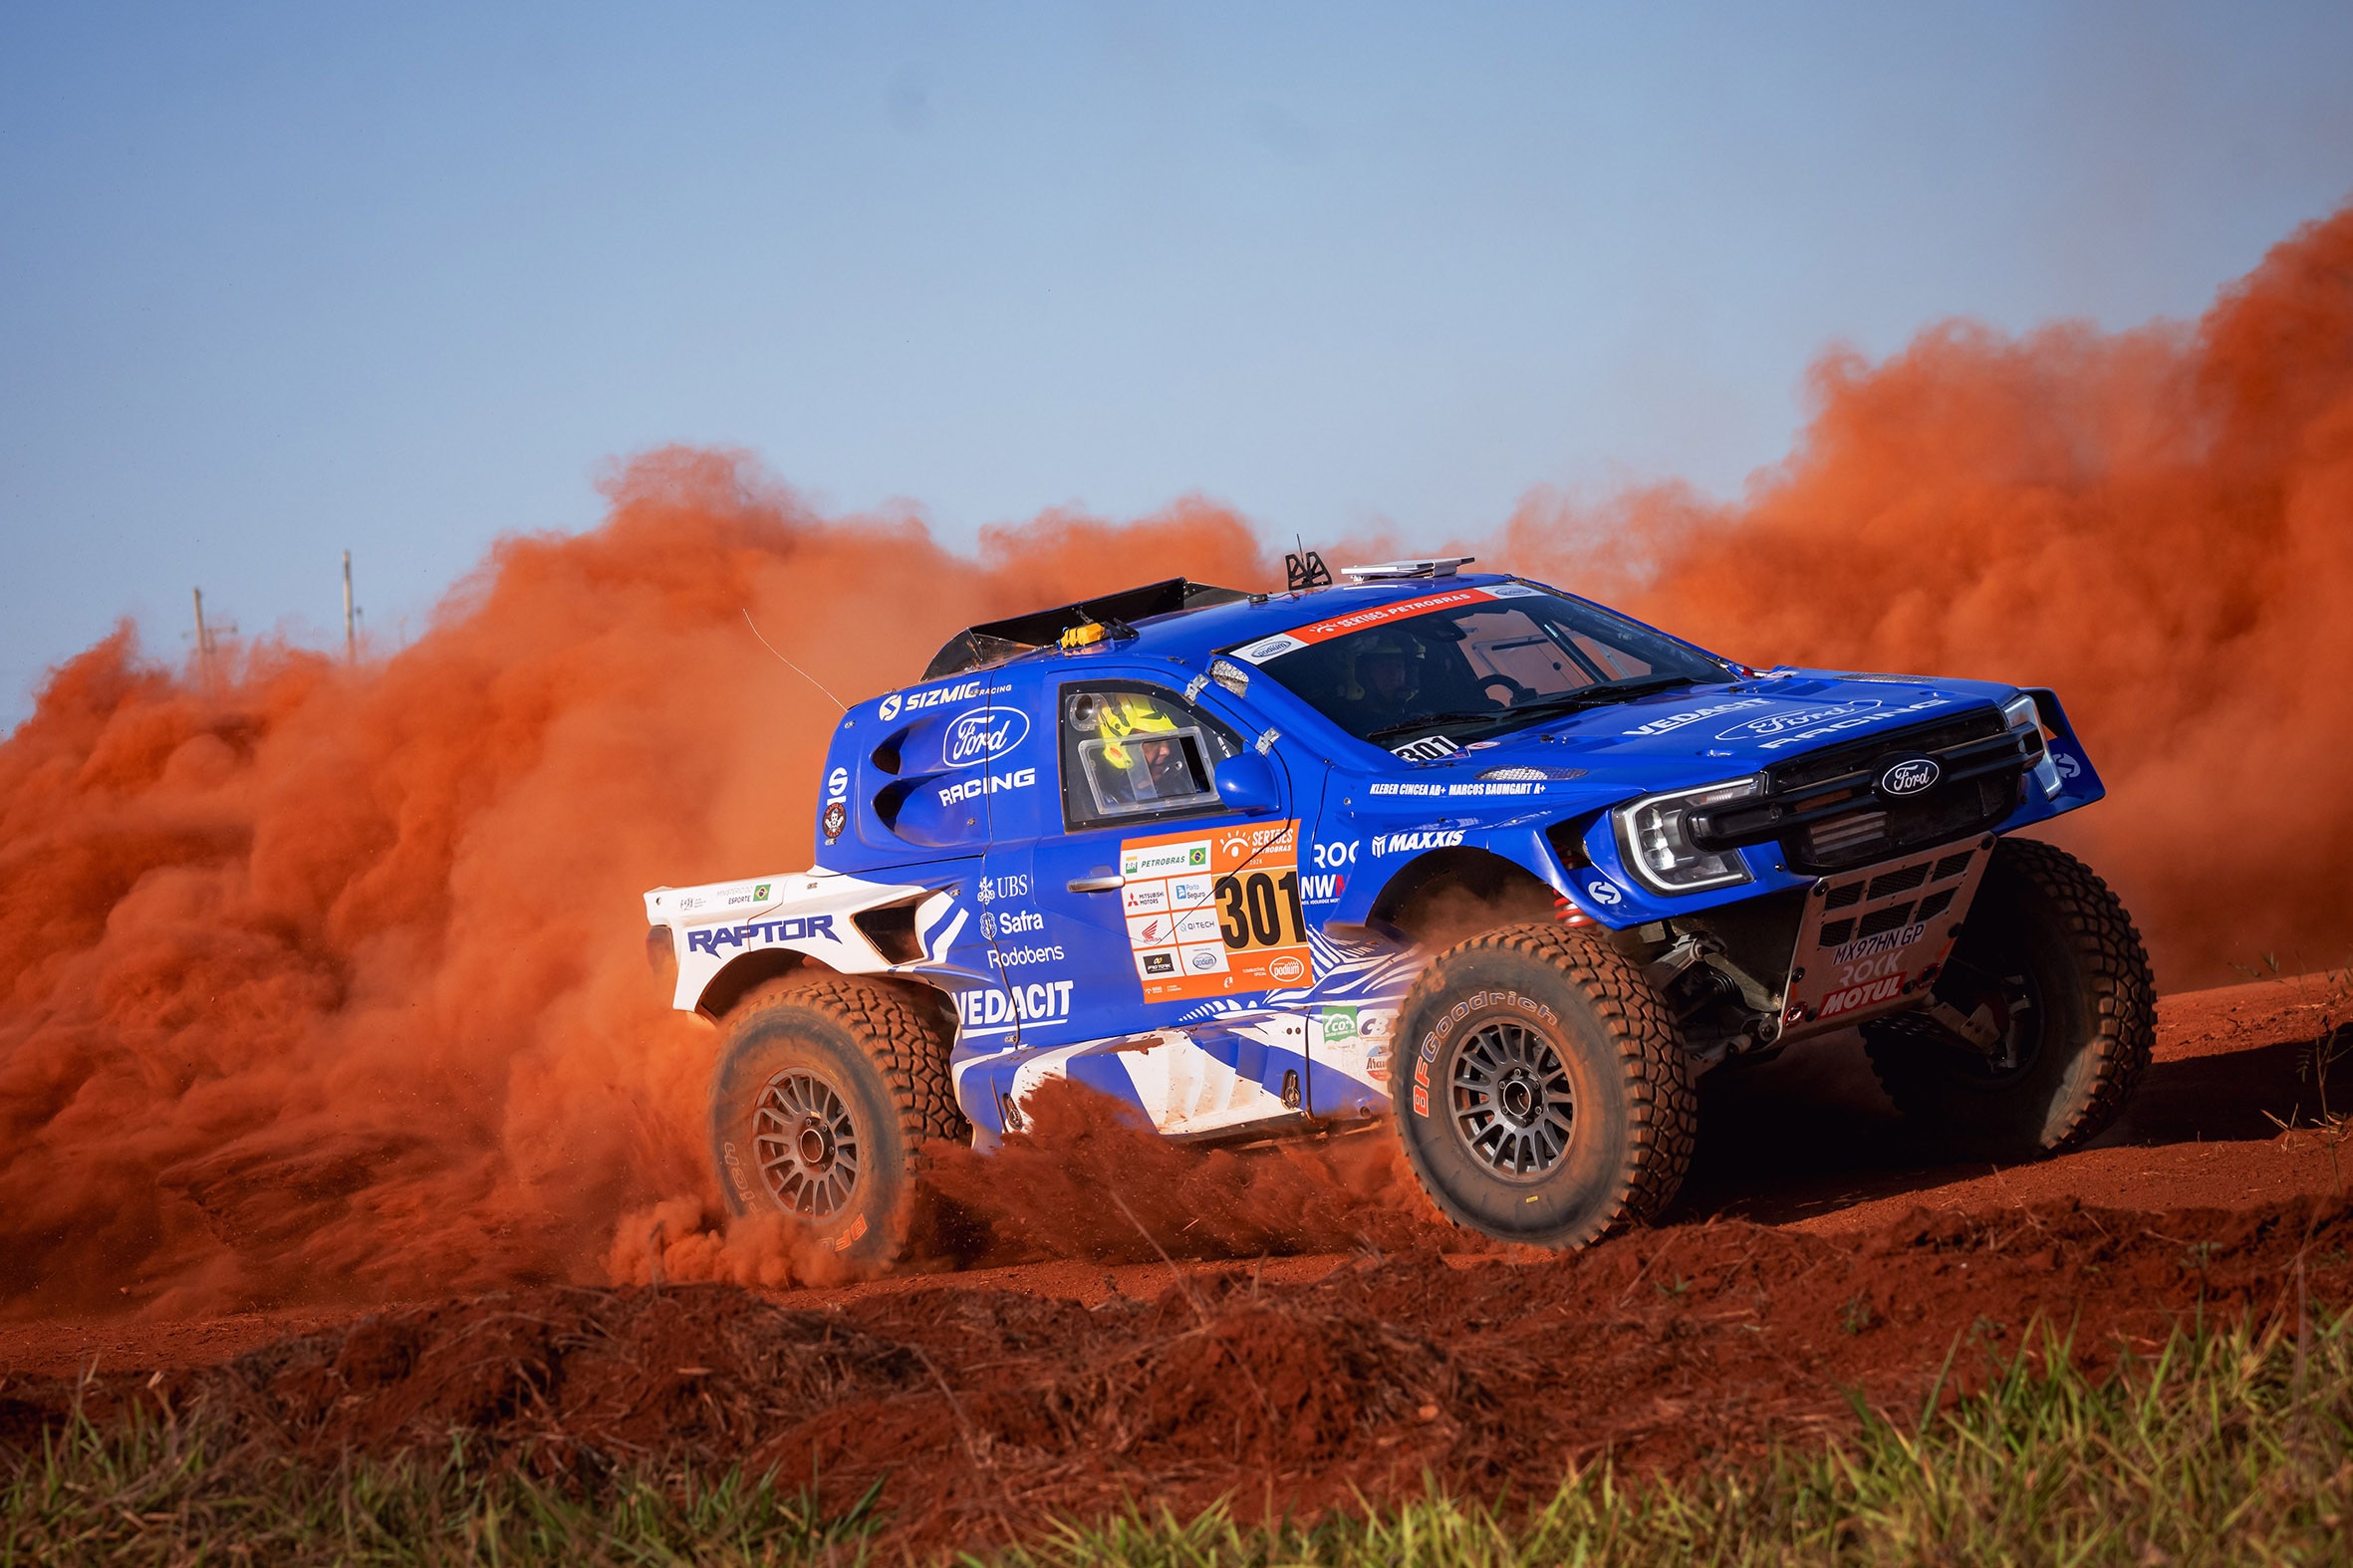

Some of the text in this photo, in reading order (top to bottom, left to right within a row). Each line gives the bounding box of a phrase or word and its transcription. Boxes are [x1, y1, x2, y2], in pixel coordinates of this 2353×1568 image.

[1388, 594, 1471, 615] PETROBRAS
[905, 681, 1012, 711] SIZMIC RACING
[1622, 697, 1772, 735] VEDACIT
[1746, 705, 1856, 733] Ford
[1757, 699, 1953, 749] RACING
[952, 714, 1011, 761] Ford
[1396, 736, 1457, 762] 301
[938, 767, 1036, 808] RACING
[1370, 783, 1400, 795] KLEBER
[1429, 784, 1446, 796] AB+
[1448, 784, 1484, 796] MARCOS
[1484, 783, 1533, 795] BAUMGART
[1533, 783, 1546, 795] A+
[1893, 765, 1931, 792] Ford
[1251, 828, 1294, 847] SERTÕES
[1251, 844, 1292, 855] PETROBRAS
[1388, 830, 1467, 853] MAXXIS
[1142, 856, 1185, 868] PETROBRAS
[997, 874, 1028, 899] UBS
[728, 895, 751, 906] ESPORTE
[1214, 871, 1308, 949] 301
[999, 910, 1045, 935] Safra
[687, 915, 844, 959] RAPTOR
[1832, 923, 1925, 966] MX97HN GP
[987, 944, 1065, 969] Rodobens
[1274, 963, 1300, 976] podium
[951, 980, 1074, 1026] VEDACIT
[1820, 975, 1902, 1016] MOTUL
[1413, 990, 1559, 1118] BFGoodrich
